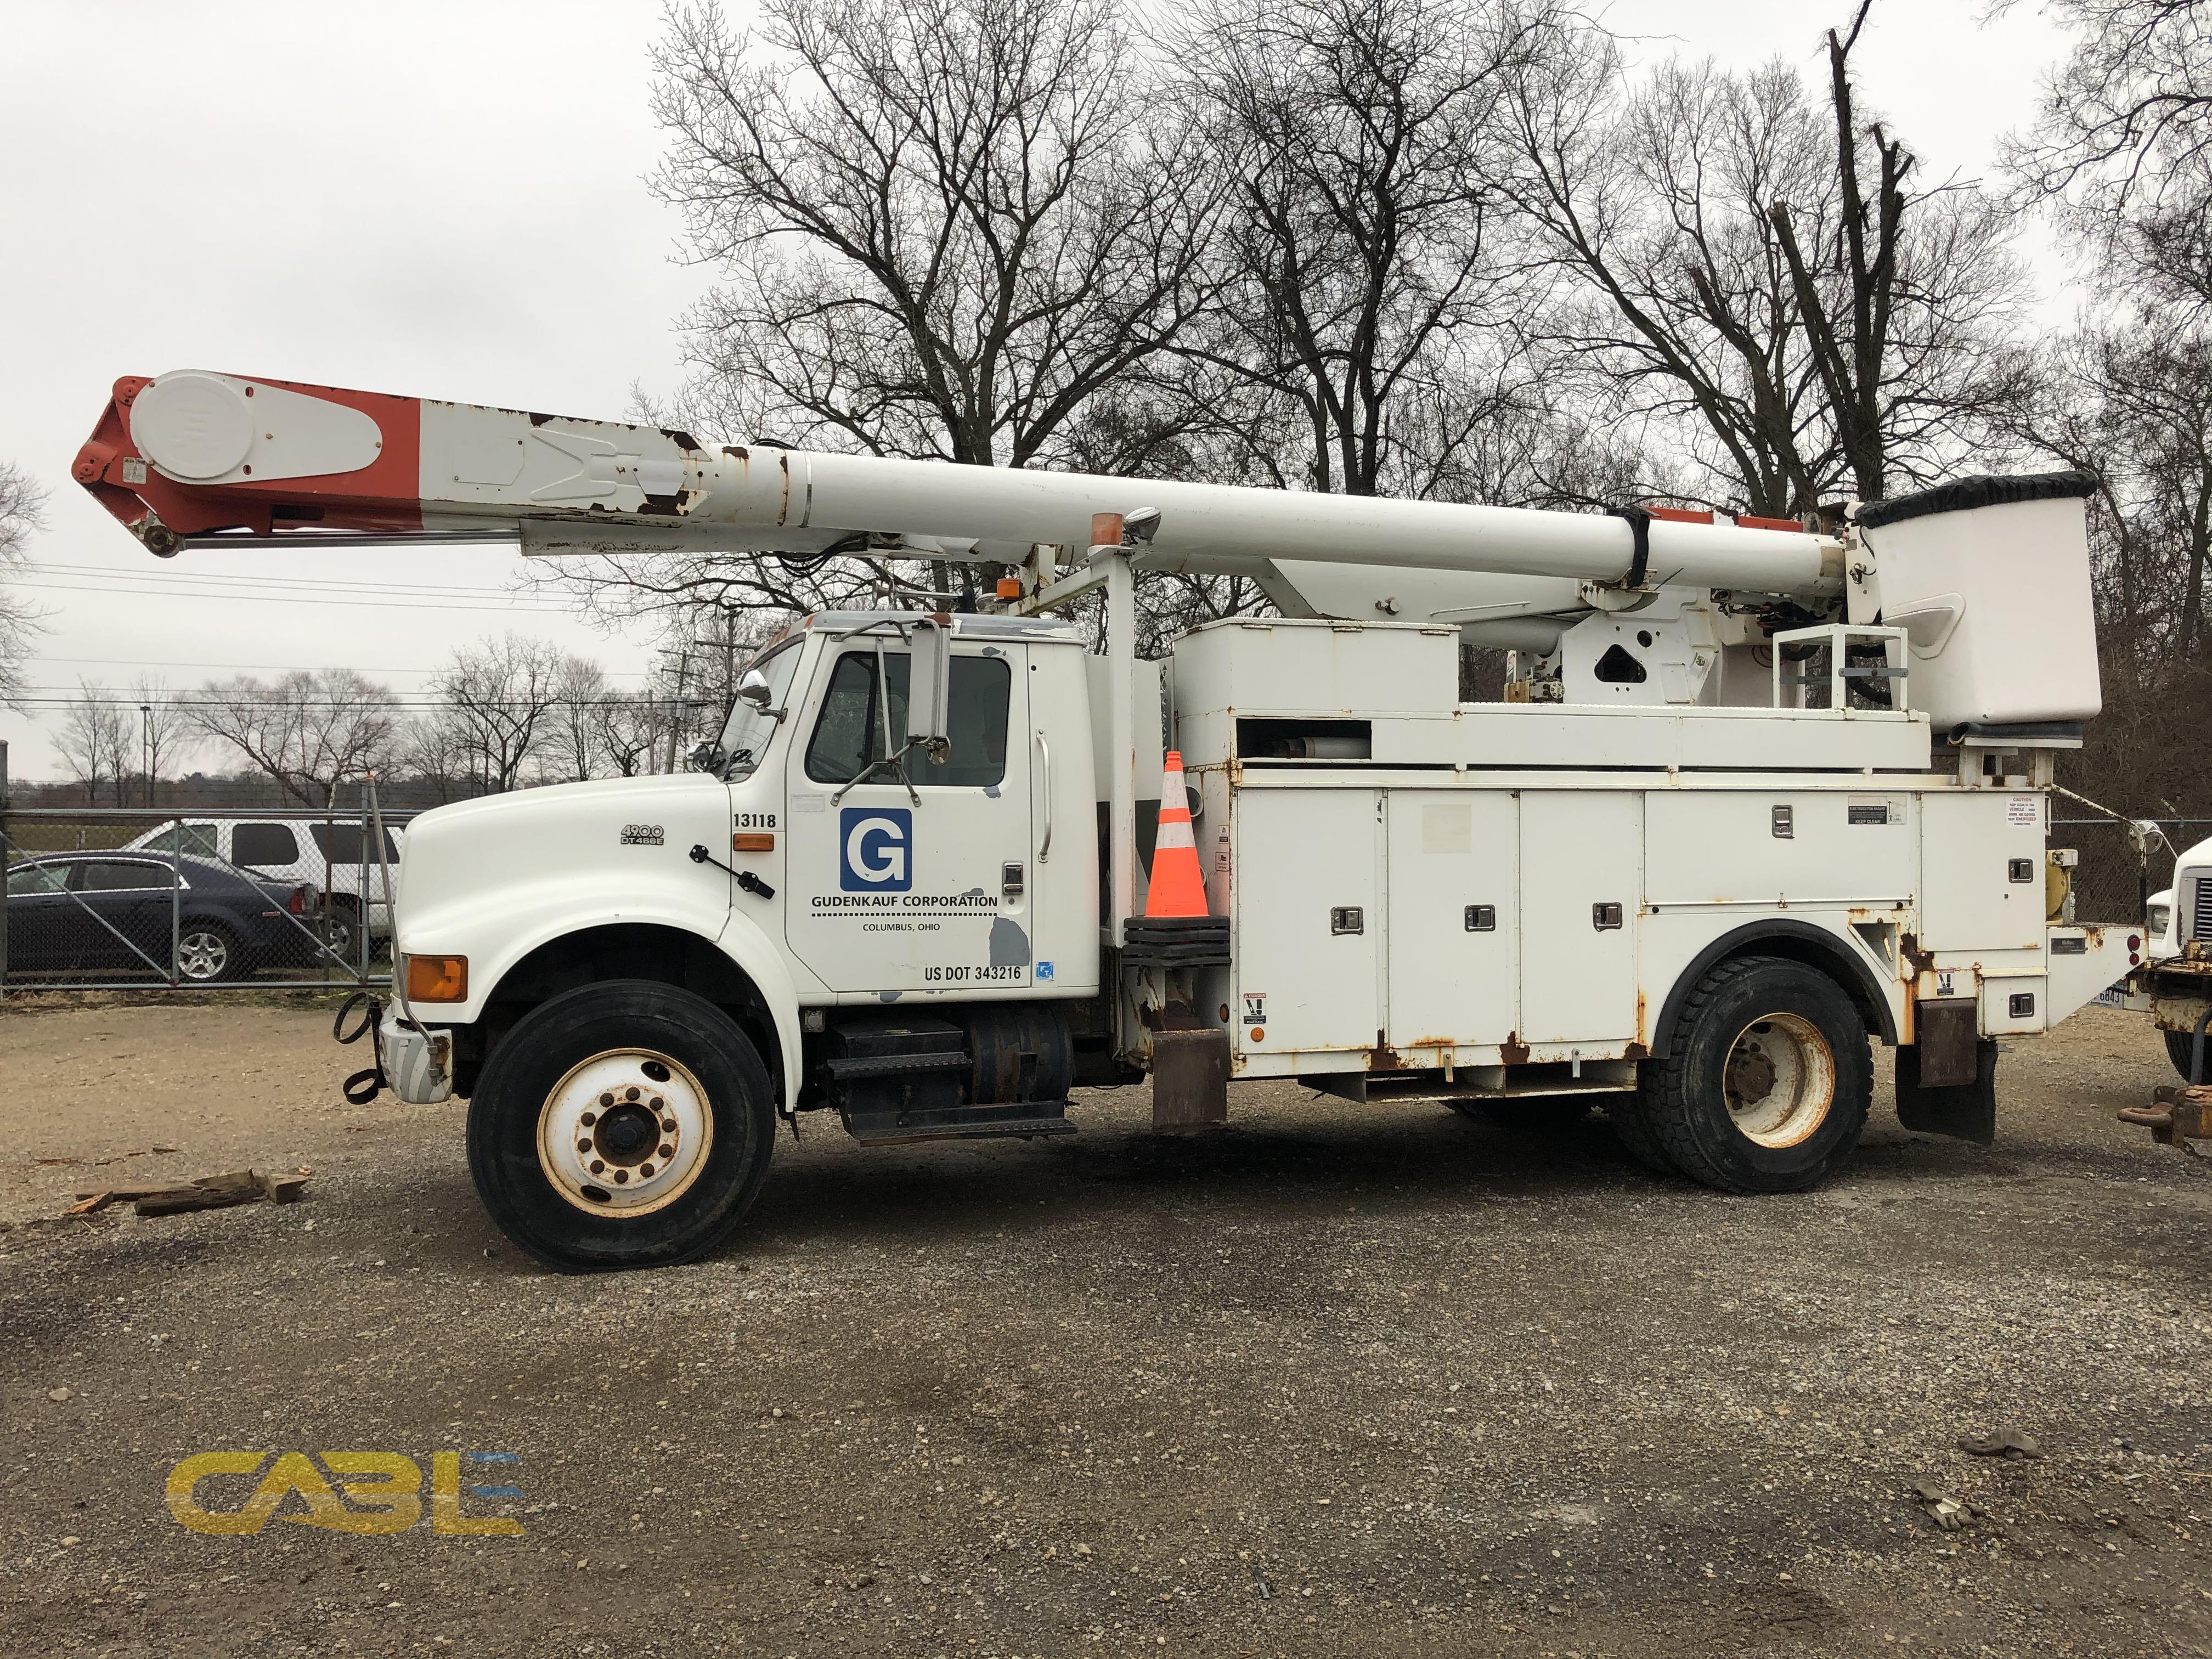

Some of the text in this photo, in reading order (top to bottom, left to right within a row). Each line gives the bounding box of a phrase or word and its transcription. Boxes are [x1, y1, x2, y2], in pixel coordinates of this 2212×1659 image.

[733, 813, 776, 828] 13118
[620, 824, 664, 837] 4900
[847, 817, 904, 882] G
[811, 896, 998, 907] GUDENKAUF CORPORATION
[862, 923, 941, 932] COLUMBUS, OHIO
[924, 966, 1022, 981] US DOT 343216
